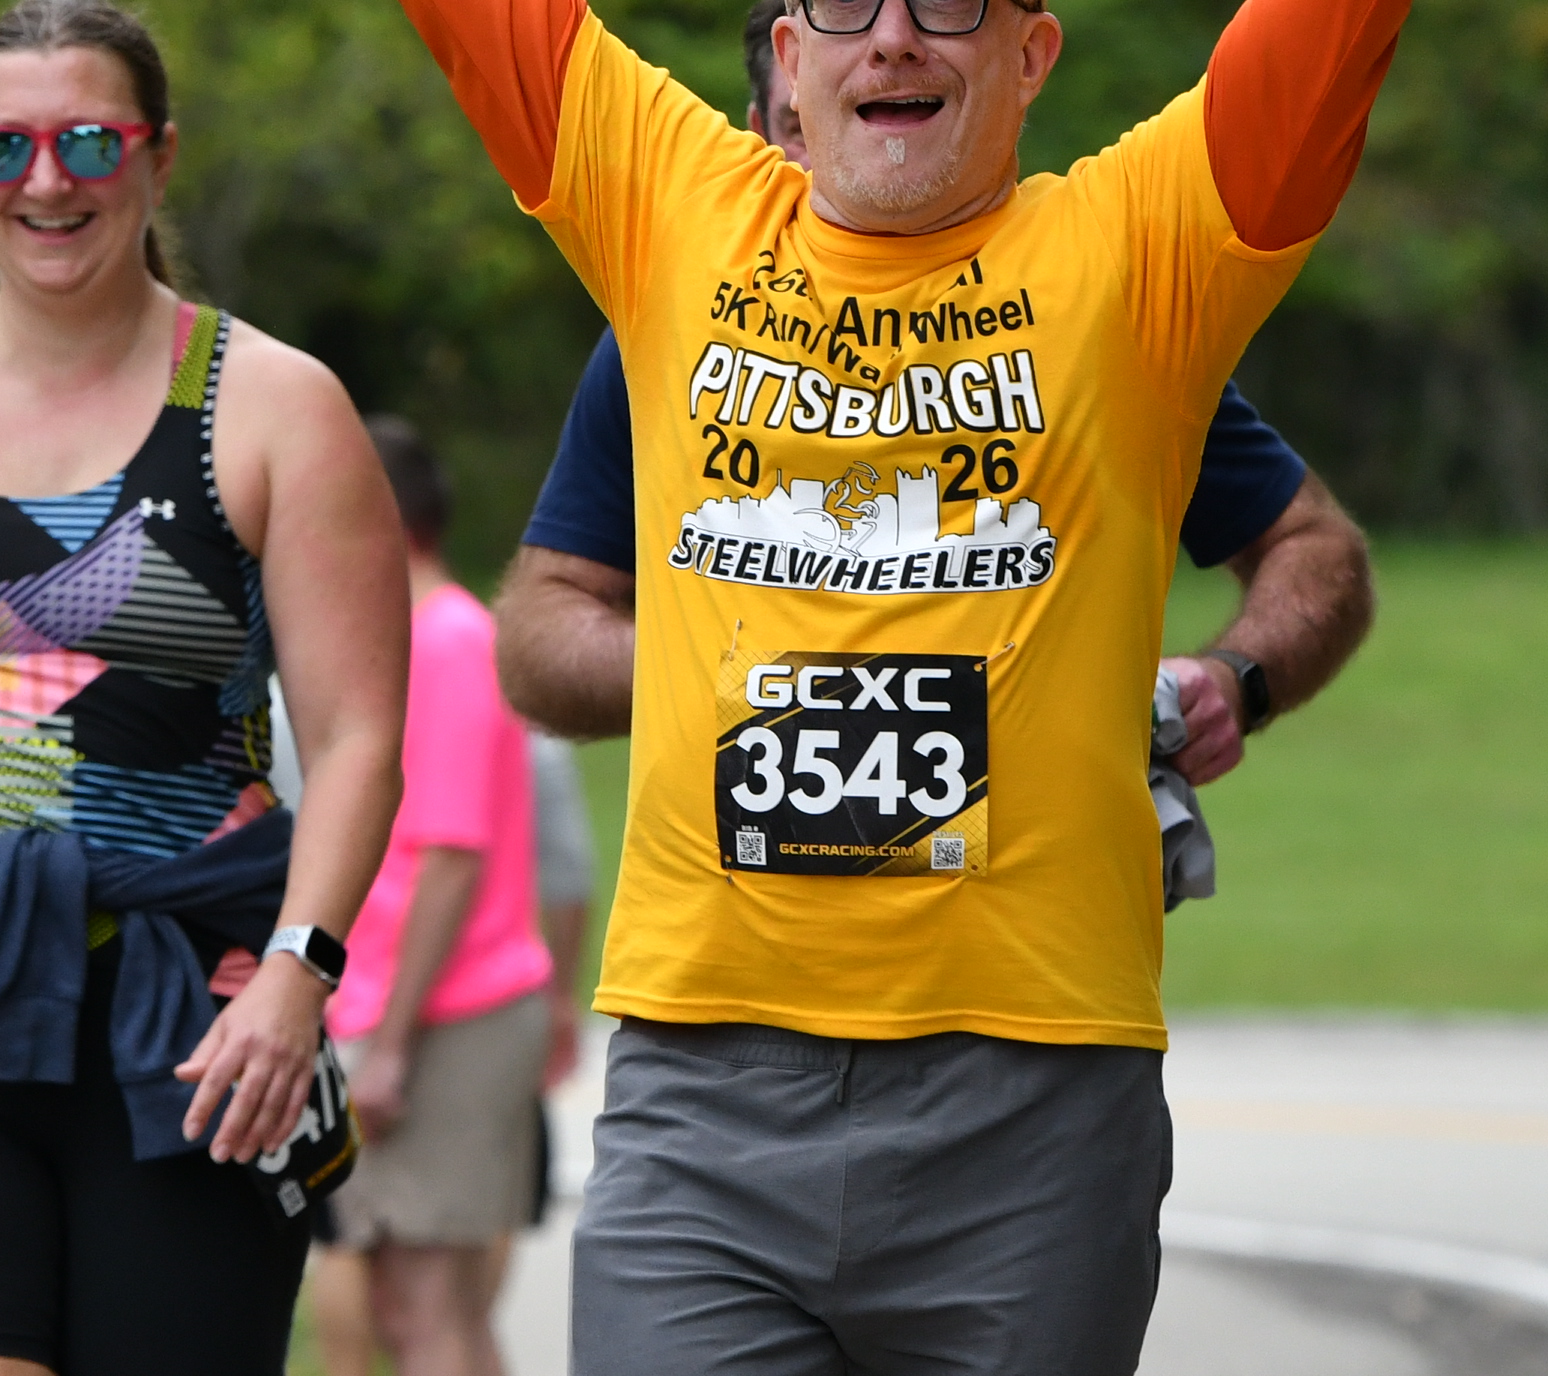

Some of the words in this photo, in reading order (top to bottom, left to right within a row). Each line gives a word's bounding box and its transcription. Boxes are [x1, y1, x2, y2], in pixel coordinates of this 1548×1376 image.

[711, 281, 760, 331] 5K
[689, 341, 1046, 438] PITTSBURGH
[703, 424, 759, 488] 20
[940, 439, 1019, 503] 26
[672, 528, 1054, 591] STEELWHEELERS
[745, 664, 951, 711] GCXC
[730, 726, 967, 818] 3543
[779, 843, 914, 857] GCXCRACING.COM
